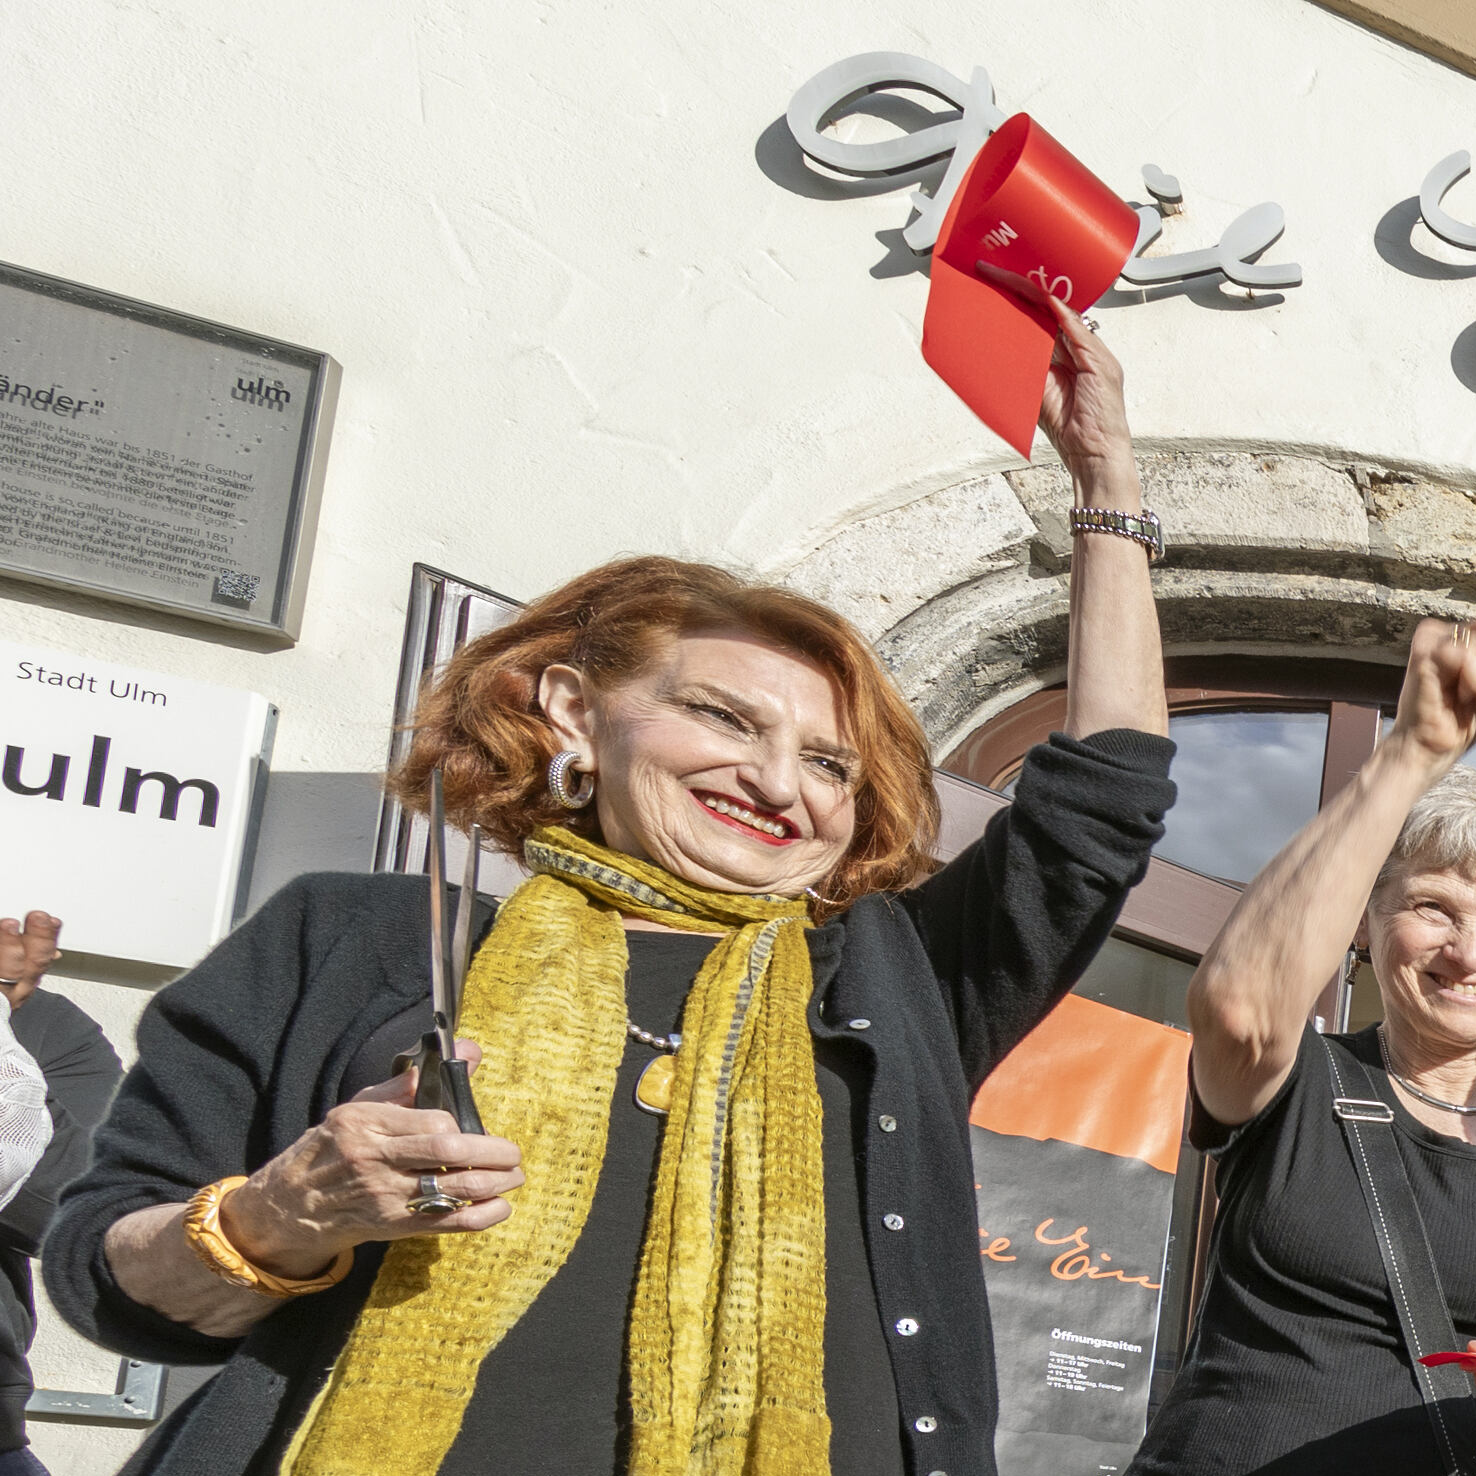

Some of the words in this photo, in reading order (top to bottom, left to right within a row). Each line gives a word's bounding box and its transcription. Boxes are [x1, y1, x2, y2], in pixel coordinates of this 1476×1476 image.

[237, 377, 290, 403] ulm
[146, 447, 174, 462] 1851
[77, 499, 114, 516] called
[172, 523, 200, 538] until
[206, 532, 233, 546] 1851
[16, 661, 98, 694] Stadt
[110, 679, 168, 707] Ulm
[1, 735, 220, 828] ulm
[1051, 1328, 1142, 1353] Öffnungszeiten
